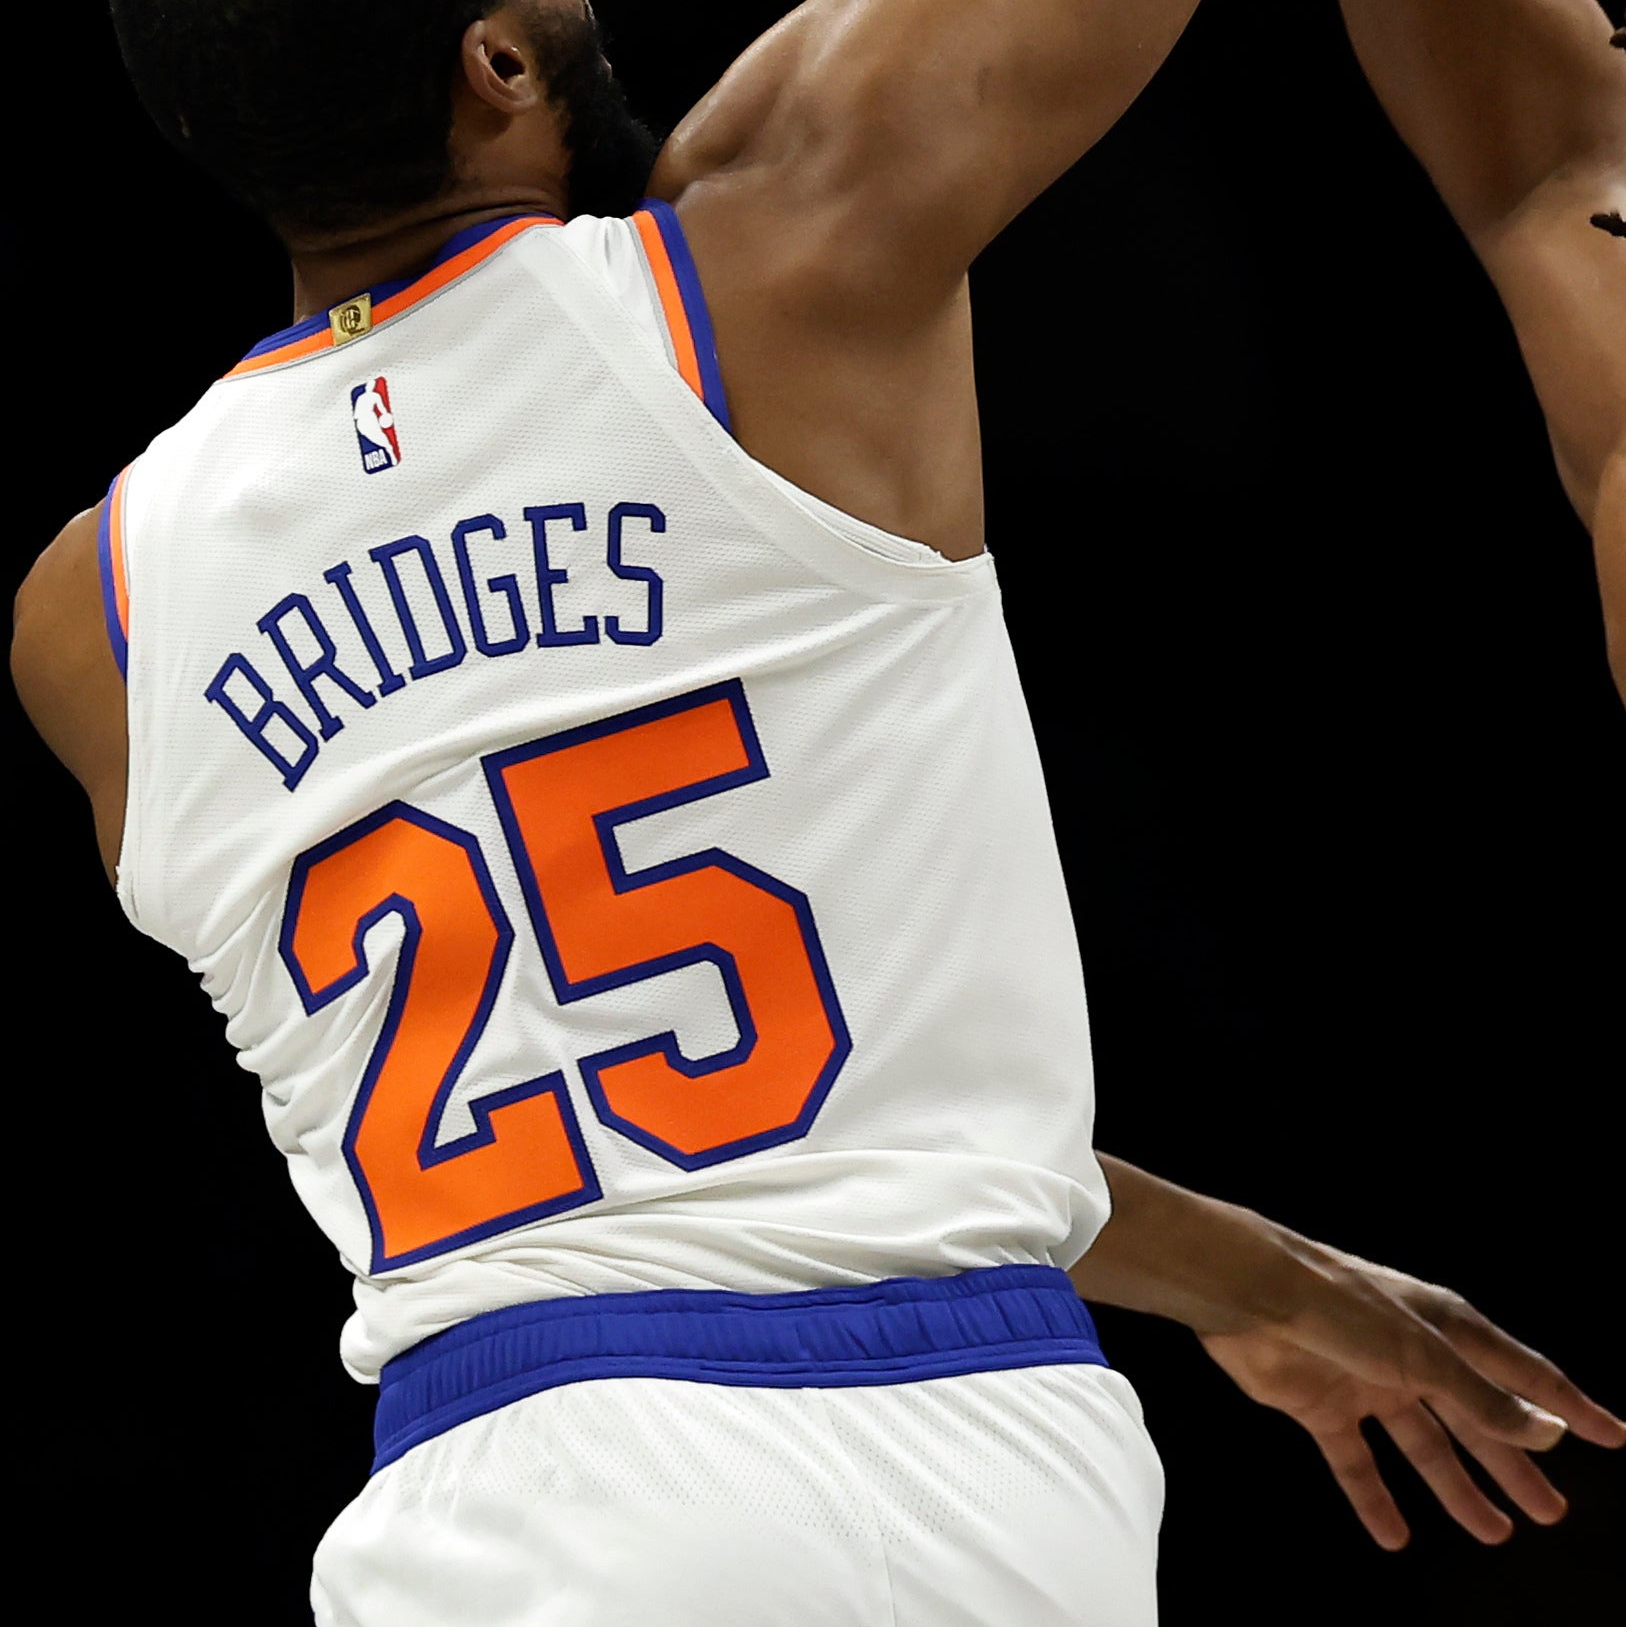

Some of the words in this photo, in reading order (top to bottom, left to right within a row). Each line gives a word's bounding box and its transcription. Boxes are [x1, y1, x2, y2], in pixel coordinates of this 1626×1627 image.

[364, 449, 388, 471] NBA
[205, 502, 667, 792] BRIDGES
[278, 677, 853, 1274] 25
